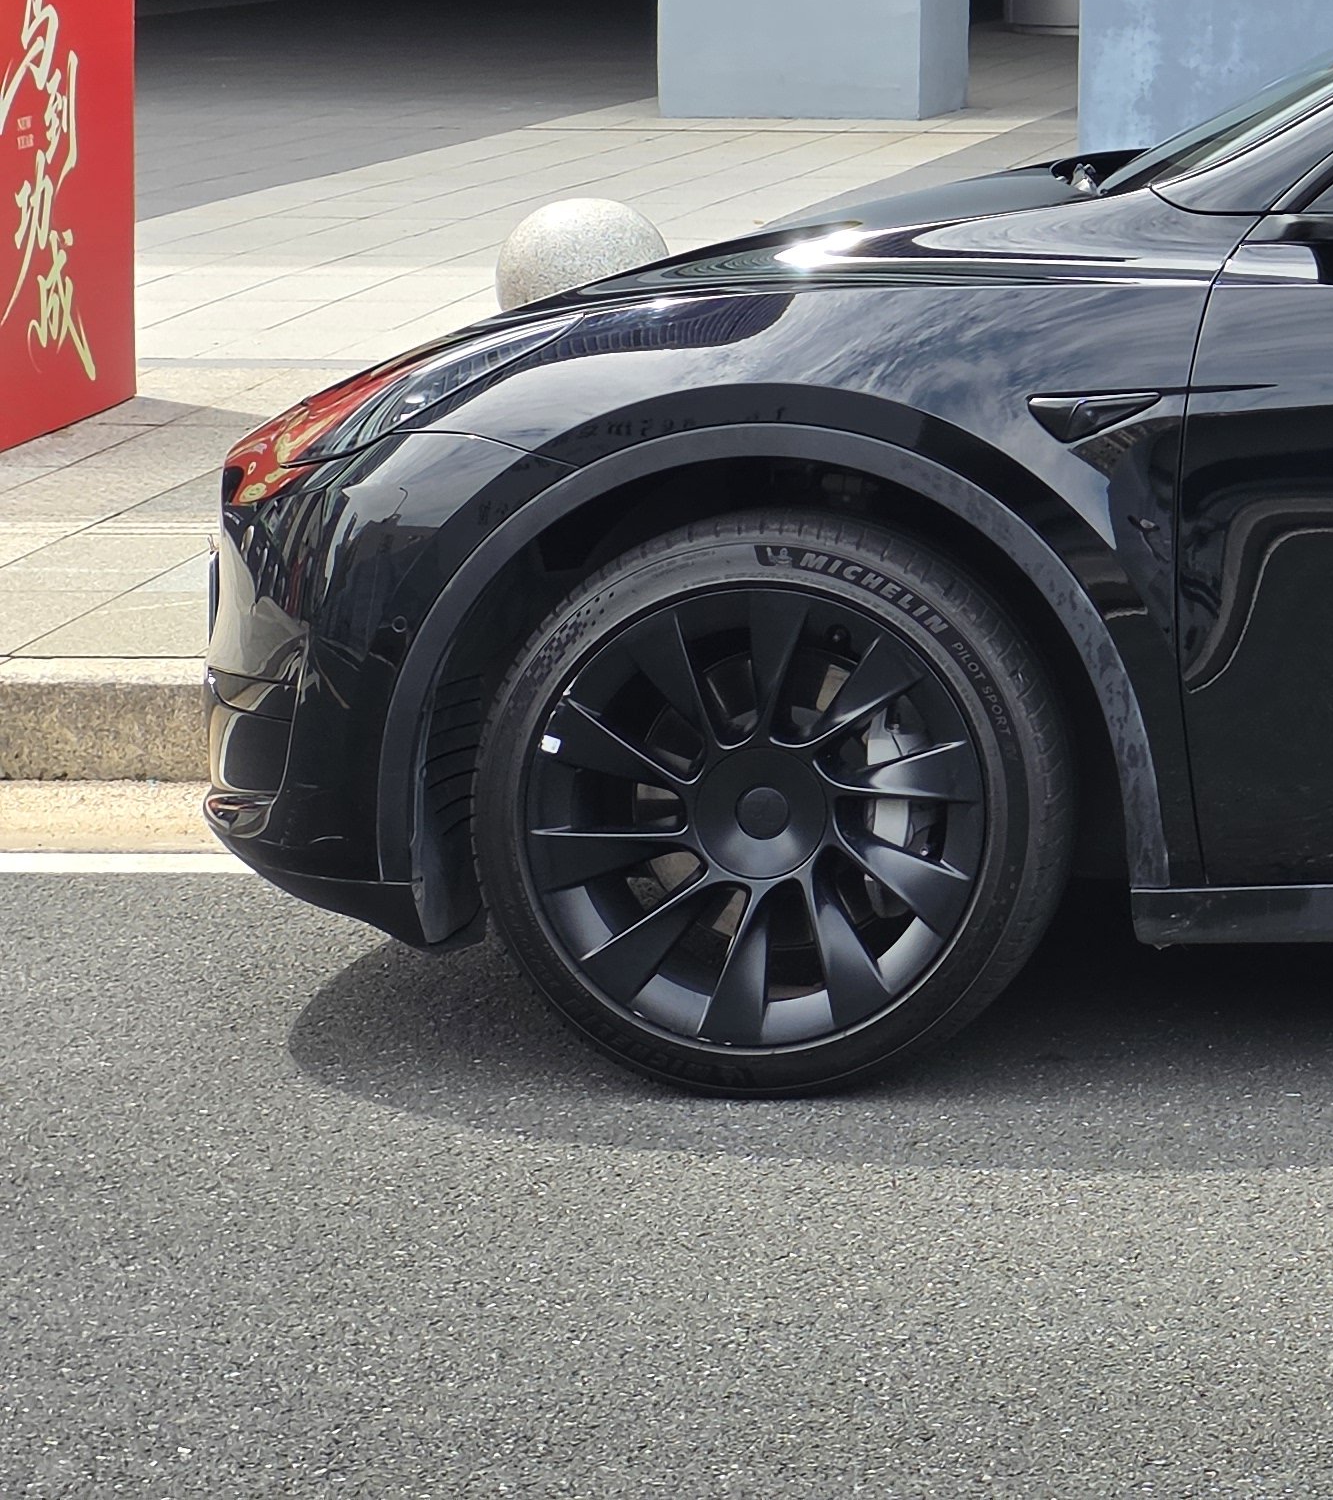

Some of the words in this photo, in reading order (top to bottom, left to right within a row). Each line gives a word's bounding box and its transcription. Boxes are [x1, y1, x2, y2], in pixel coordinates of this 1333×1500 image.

[799, 551, 949, 634] MICHELIN
[951, 641, 987, 681] PILOT
[982, 685, 1012, 736] SPORT
